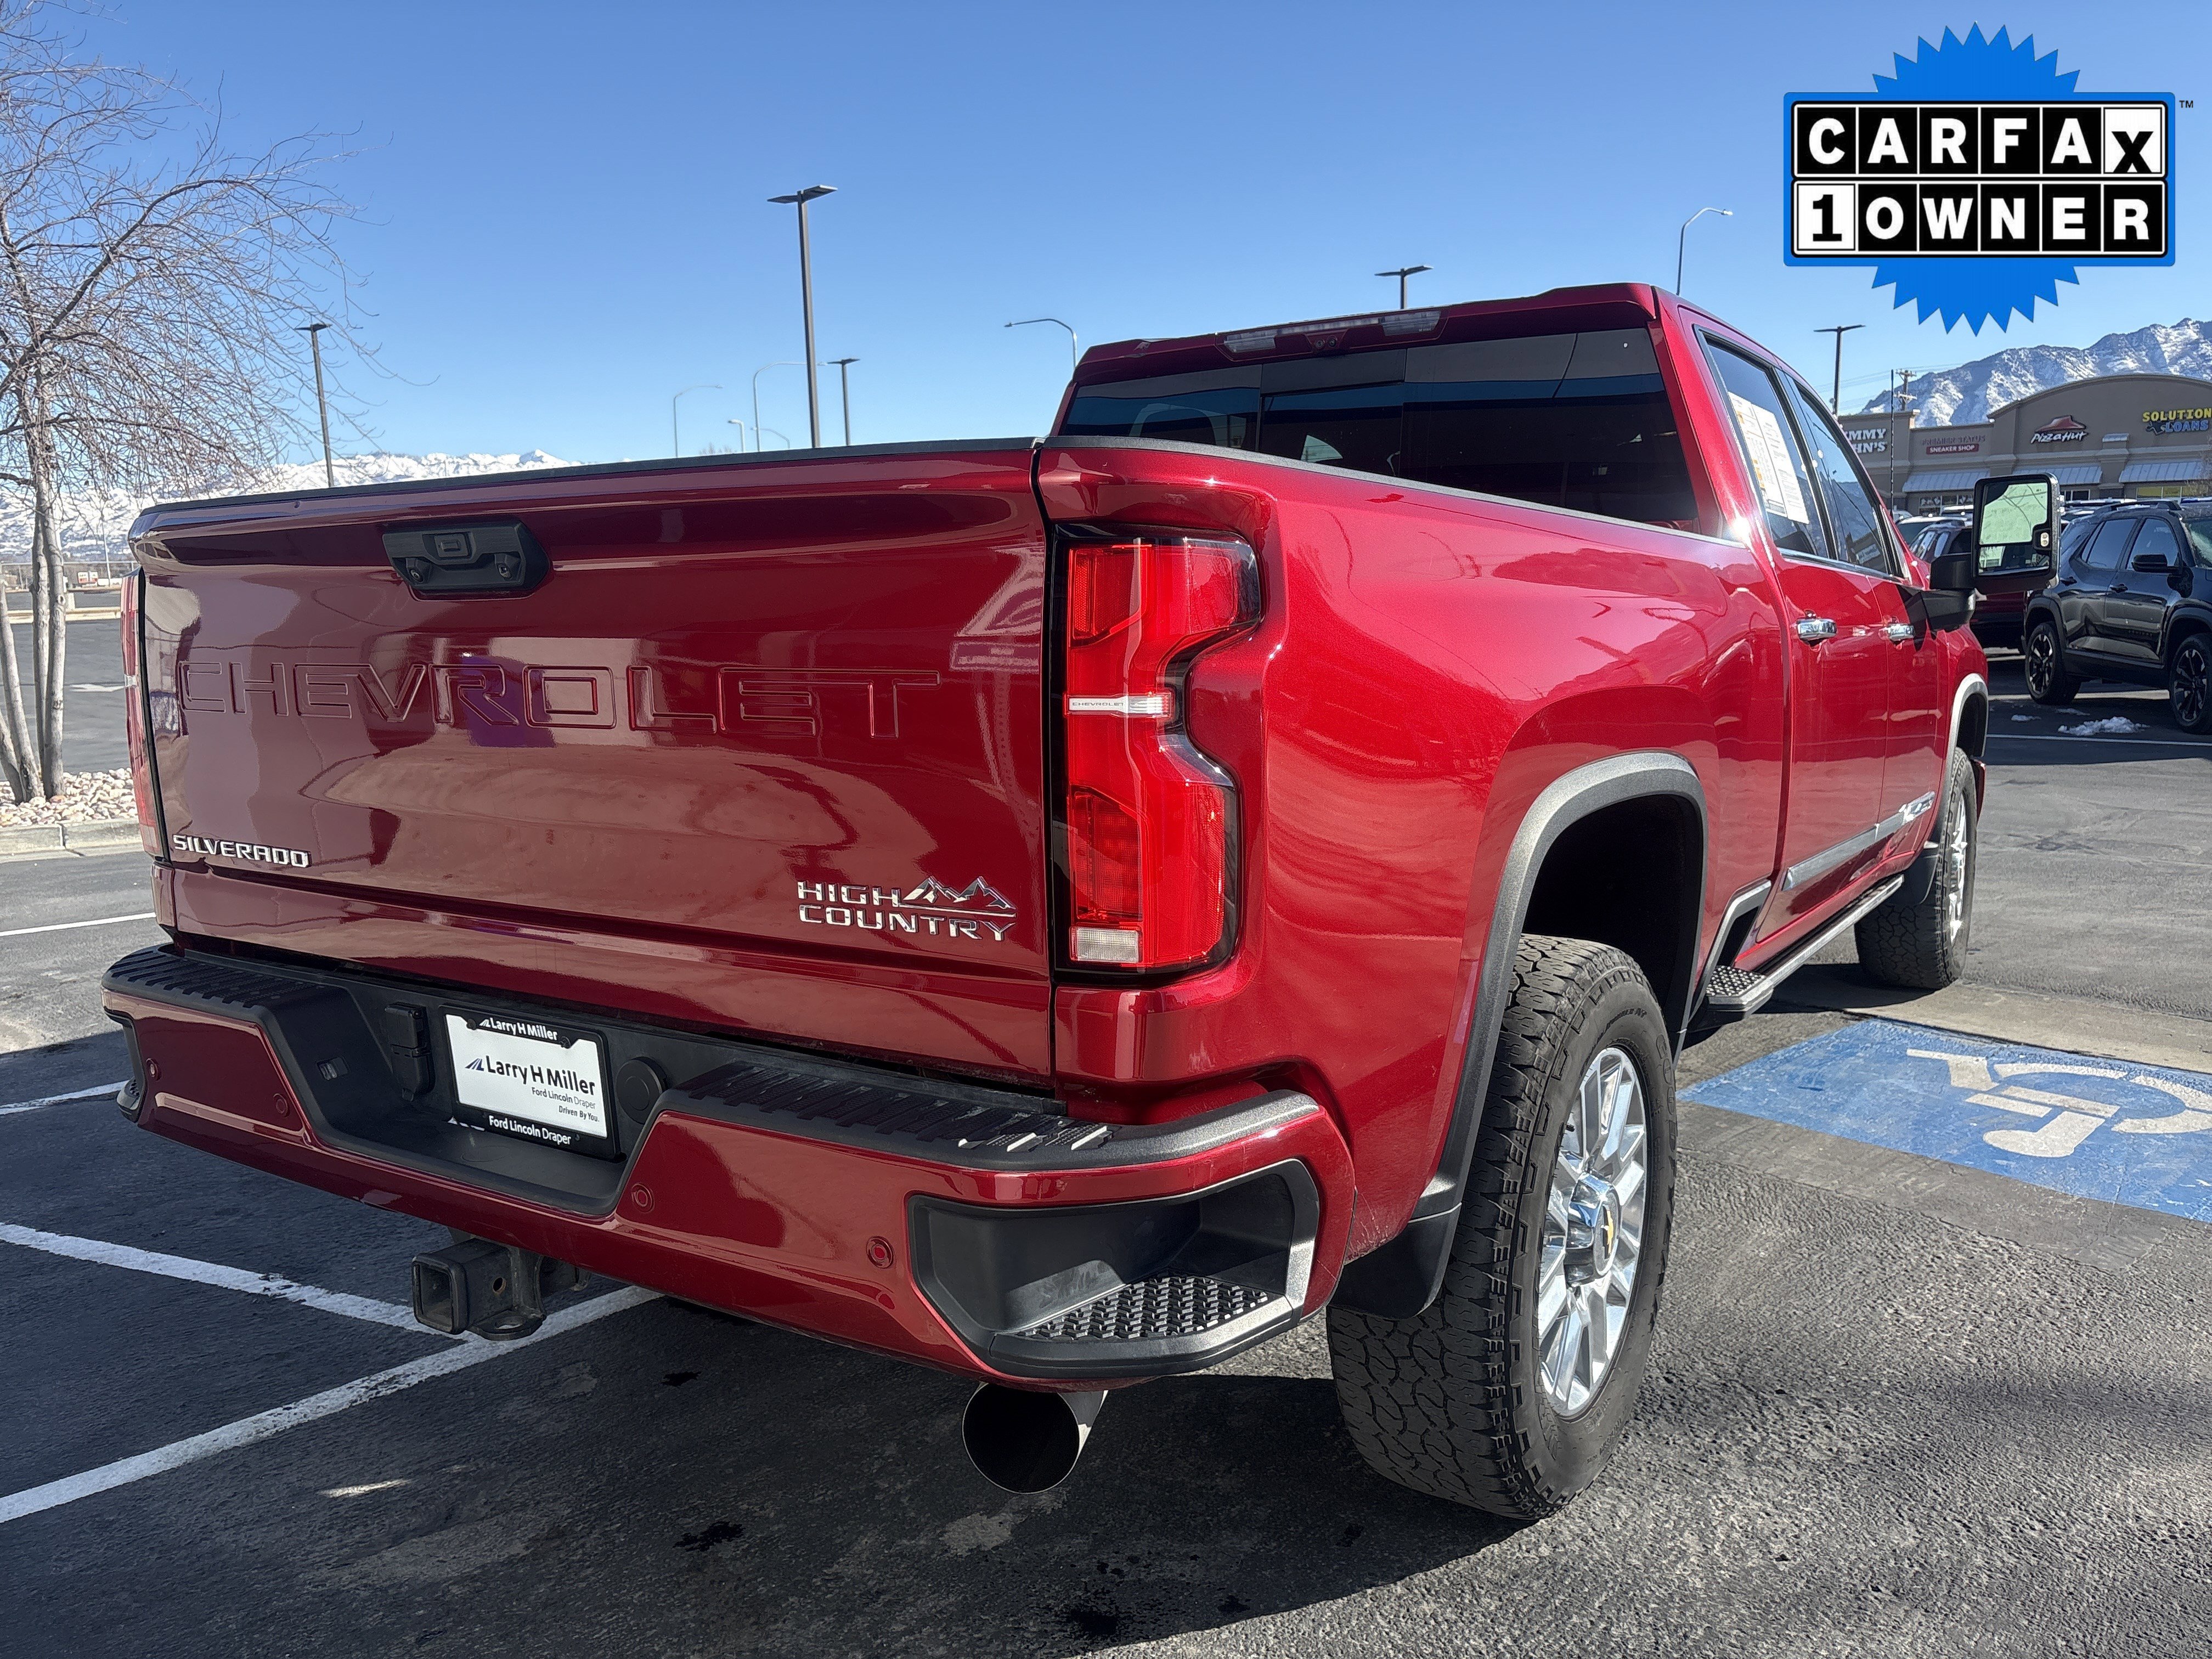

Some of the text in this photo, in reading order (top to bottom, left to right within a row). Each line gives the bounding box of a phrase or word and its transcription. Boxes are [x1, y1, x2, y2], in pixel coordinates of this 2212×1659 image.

[2142, 408, 2212, 422] SOLUTION
[2165, 420, 2209, 432] LOANS
[1844, 428, 1886, 441] MMY
[2030, 431, 2087, 444] Pizza Hut
[1852, 441, 1886, 453] HN'S
[178, 662, 941, 738] CHEVROLET
[173, 834, 312, 868] SILVERADO
[798, 880, 901, 907] HIGH
[799, 904, 1016, 941] COUNTRY
[489, 1017, 558, 1041] Larry H Miller
[486, 1055, 595, 1096] Larry H Miller
[531, 1086, 596, 1110] Ford Lincoln Draper
[558, 1105, 600, 1122] Driven By You.
[489, 1115, 572, 1146] Ford Lincoln Draper
